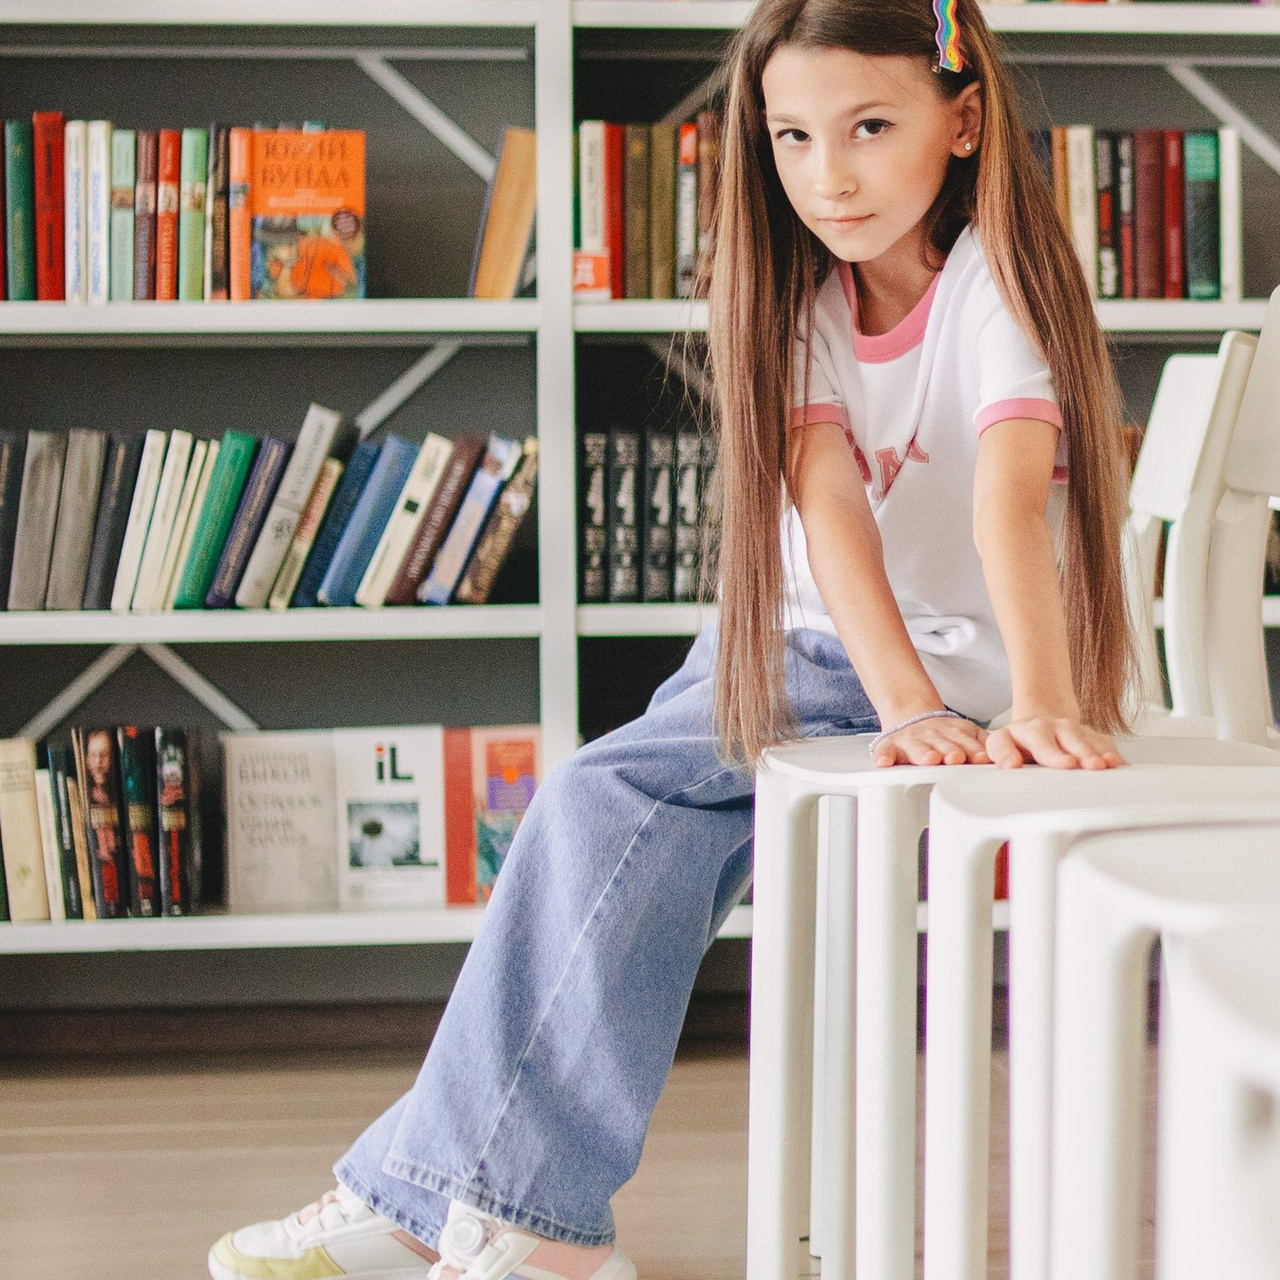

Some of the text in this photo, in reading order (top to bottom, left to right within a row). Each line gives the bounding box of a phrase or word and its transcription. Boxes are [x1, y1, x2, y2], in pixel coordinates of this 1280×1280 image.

[264, 136, 349, 162] ЮРИЙ
[261, 164, 351, 188] БУЙДА
[375, 744, 414, 781] iL
